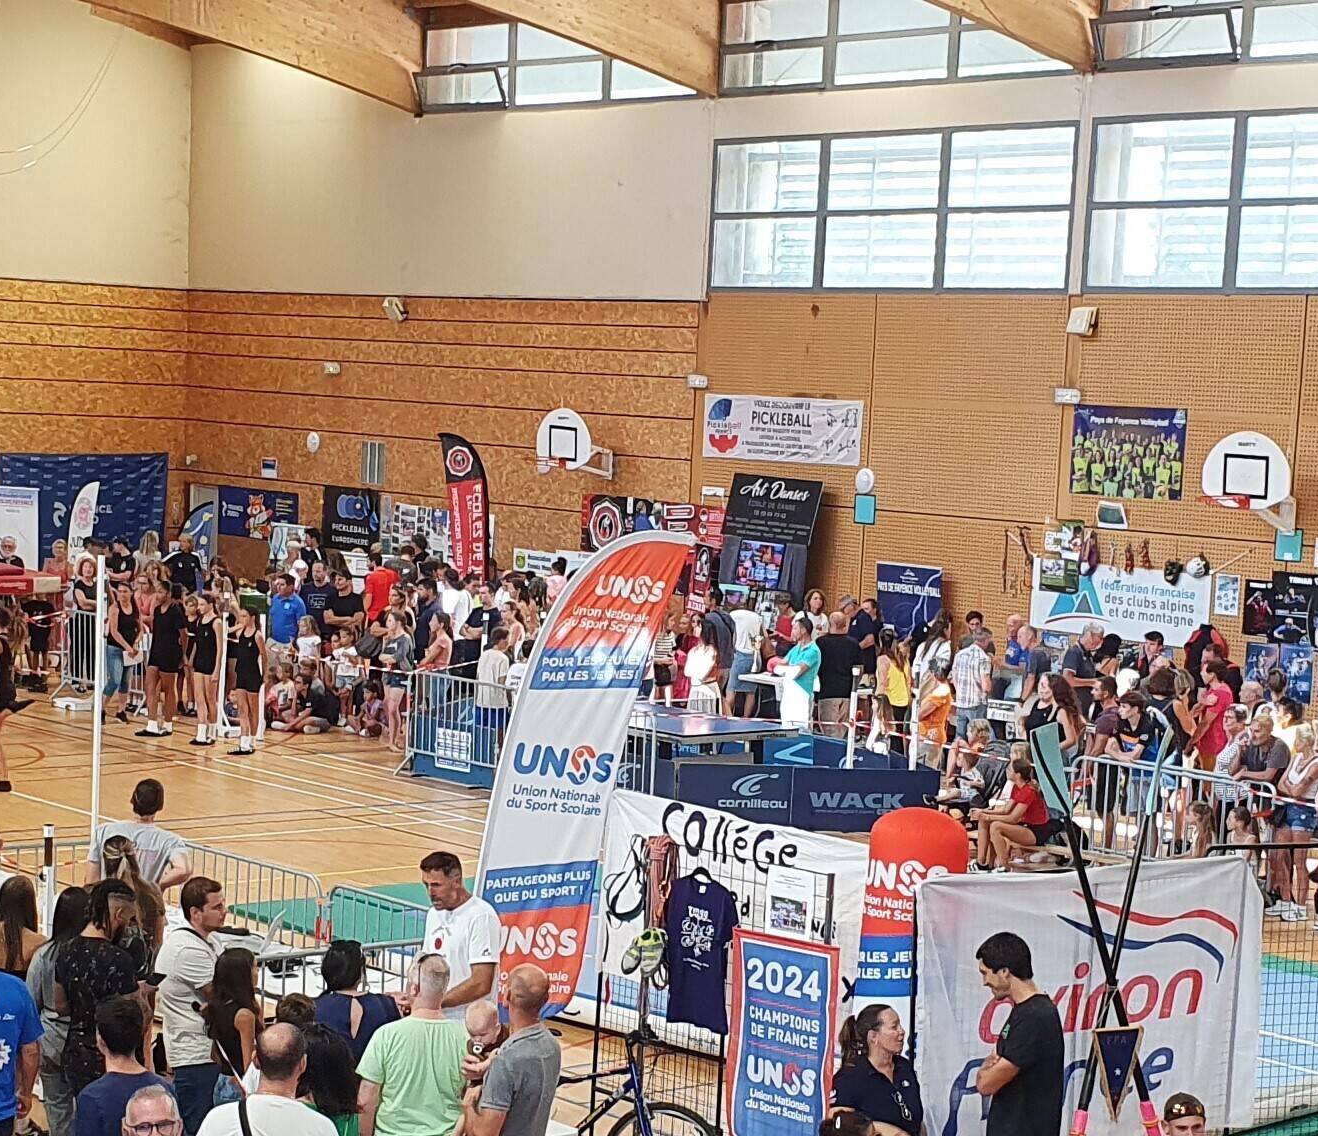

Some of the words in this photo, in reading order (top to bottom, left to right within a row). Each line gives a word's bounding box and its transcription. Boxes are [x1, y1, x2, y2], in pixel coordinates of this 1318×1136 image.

[751, 410, 813, 428] PICKLEBALL
[594, 574, 666, 605] UNSS
[1101, 579, 1149, 595] fédération
[1151, 583, 1196, 600] française
[1105, 594, 1124, 607] des
[1127, 594, 1157, 609] clubs
[1160, 599, 1195, 615] alpins
[1109, 607, 1119, 618] et
[1121, 608, 1136, 619] de
[1137, 611, 1194, 627] montagne
[542, 656, 574, 668] POUR
[542, 671, 566, 682] PAR
[567, 670, 589, 682] LES
[514, 742, 615, 785] UNSS
[512, 784, 548, 798] Union
[550, 787, 601, 804] Nationale
[809, 791, 906, 808] WACK
[506, 797, 522, 808] du
[524, 799, 558, 813] Sport
[561, 802, 601, 816] Scolaire
[486, 874, 562, 890] PARTAGEONS
[563, 870, 592, 881] PLUS
[494, 891, 519, 904] QUE
[522, 889, 537, 900] DU
[540, 886, 577, 899] SPORT
[867, 951, 889, 963] LES
[746, 957, 822, 1002] 2024
[862, 968, 881, 979] LES
[749, 1005, 820, 1034] CHAMPIONS
[751, 1022, 765, 1039] DE
[767, 1027, 818, 1050] FRANCE
[747, 1054, 817, 1097] UNSS
[745, 1098, 758, 1109] du
[759, 1101, 781, 1117] Sport
[782, 1107, 814, 1124] Scolaire
[750, 1088, 773, 1103] Union
[774, 1094, 810, 1114] Nationale
